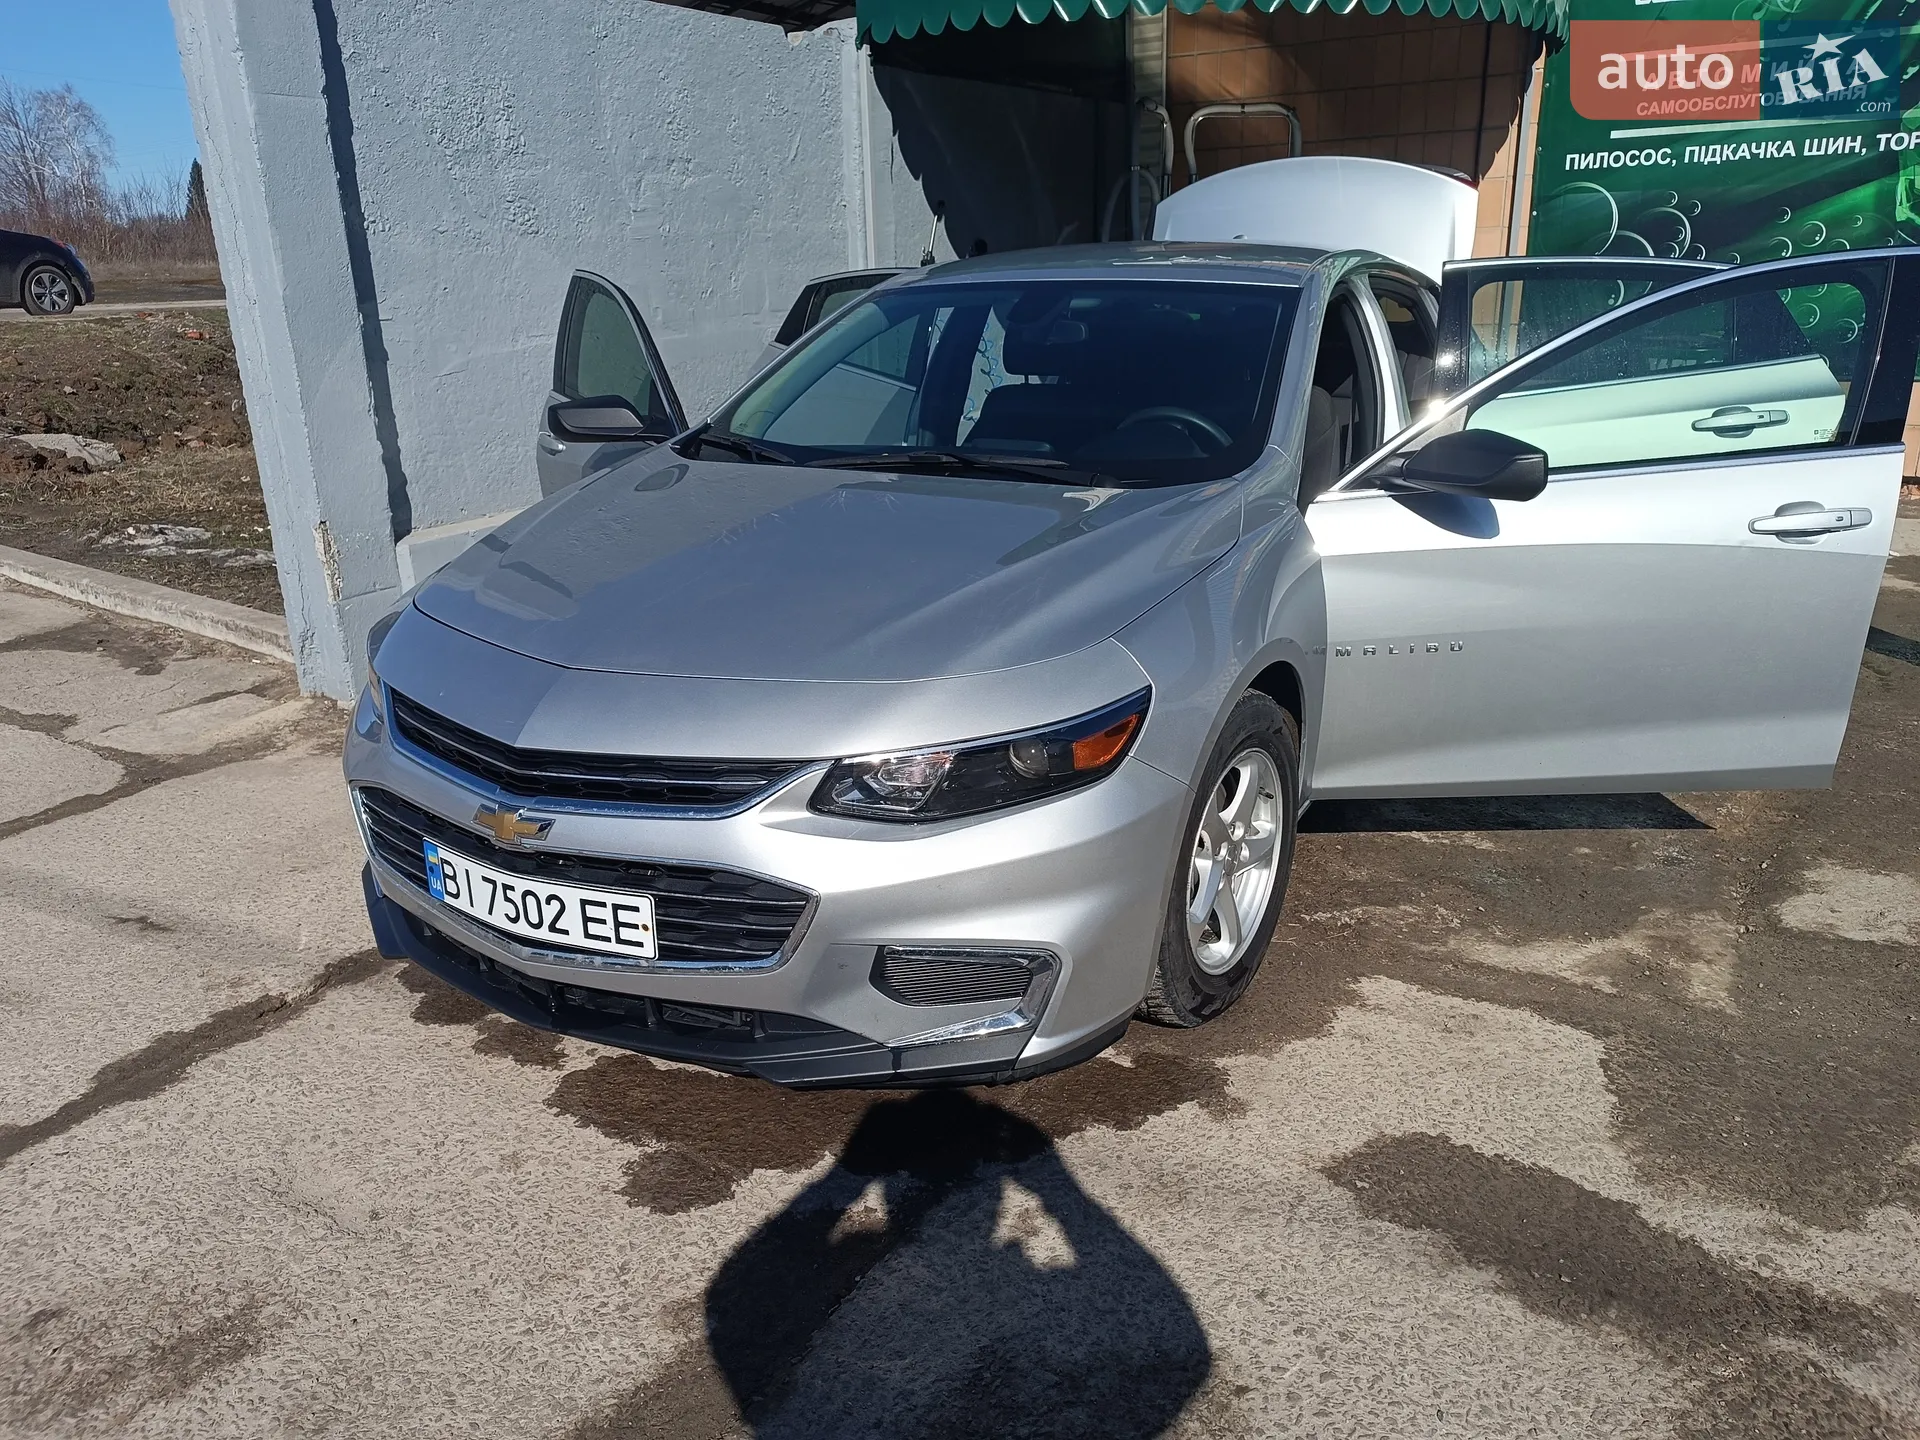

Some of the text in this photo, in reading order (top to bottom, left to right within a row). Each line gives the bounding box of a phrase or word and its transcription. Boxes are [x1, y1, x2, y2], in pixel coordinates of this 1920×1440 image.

[1565, 147, 1677, 171] ПИЛОСОС,
[1684, 140, 1796, 165] ПІДКАЧКА
[1803, 135, 1867, 156] ШИН,
[1335, 641, 1464, 657] MALIBU
[431, 876, 442, 892] UA
[440, 857, 645, 948] BI 7502 EE
